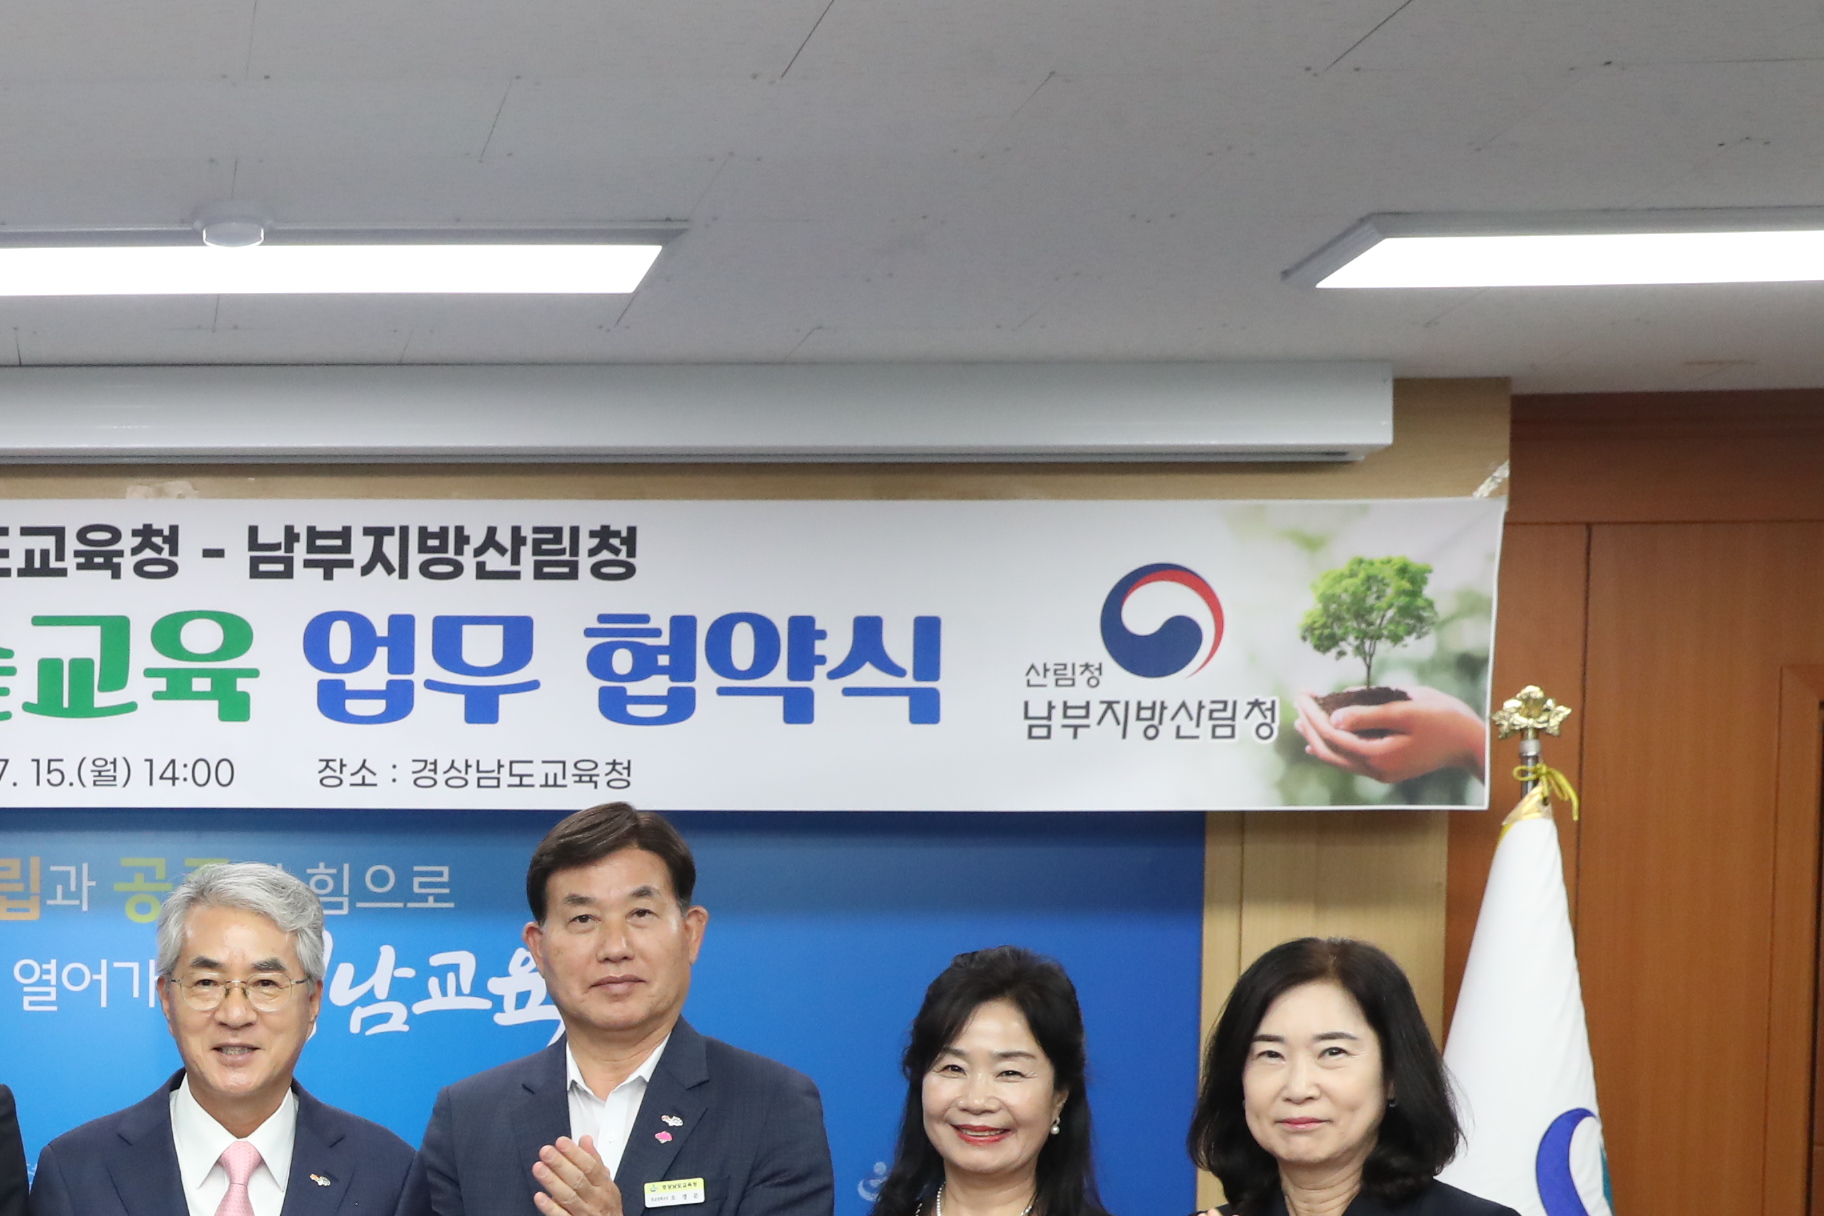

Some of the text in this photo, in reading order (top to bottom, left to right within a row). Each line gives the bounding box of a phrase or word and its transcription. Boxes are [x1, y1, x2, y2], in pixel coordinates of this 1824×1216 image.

[247, 523, 639, 582] 남부지방산림청
[302, 610, 541, 726] 업무
[583, 611, 942, 727] 협약식
[1025, 662, 1103, 689] 산림청
[1023, 699, 1279, 742] 남부지방산림청
[31, 756, 132, 789] 15.(월)
[144, 757, 235, 788] 14:00
[318, 758, 378, 789] 장소
[411, 758, 632, 790] 경상남도교육청
[306, 863, 455, 915] 힘으로
[13, 958, 161, 1012] 열어가
[306, 930, 565, 1048] 남교육
